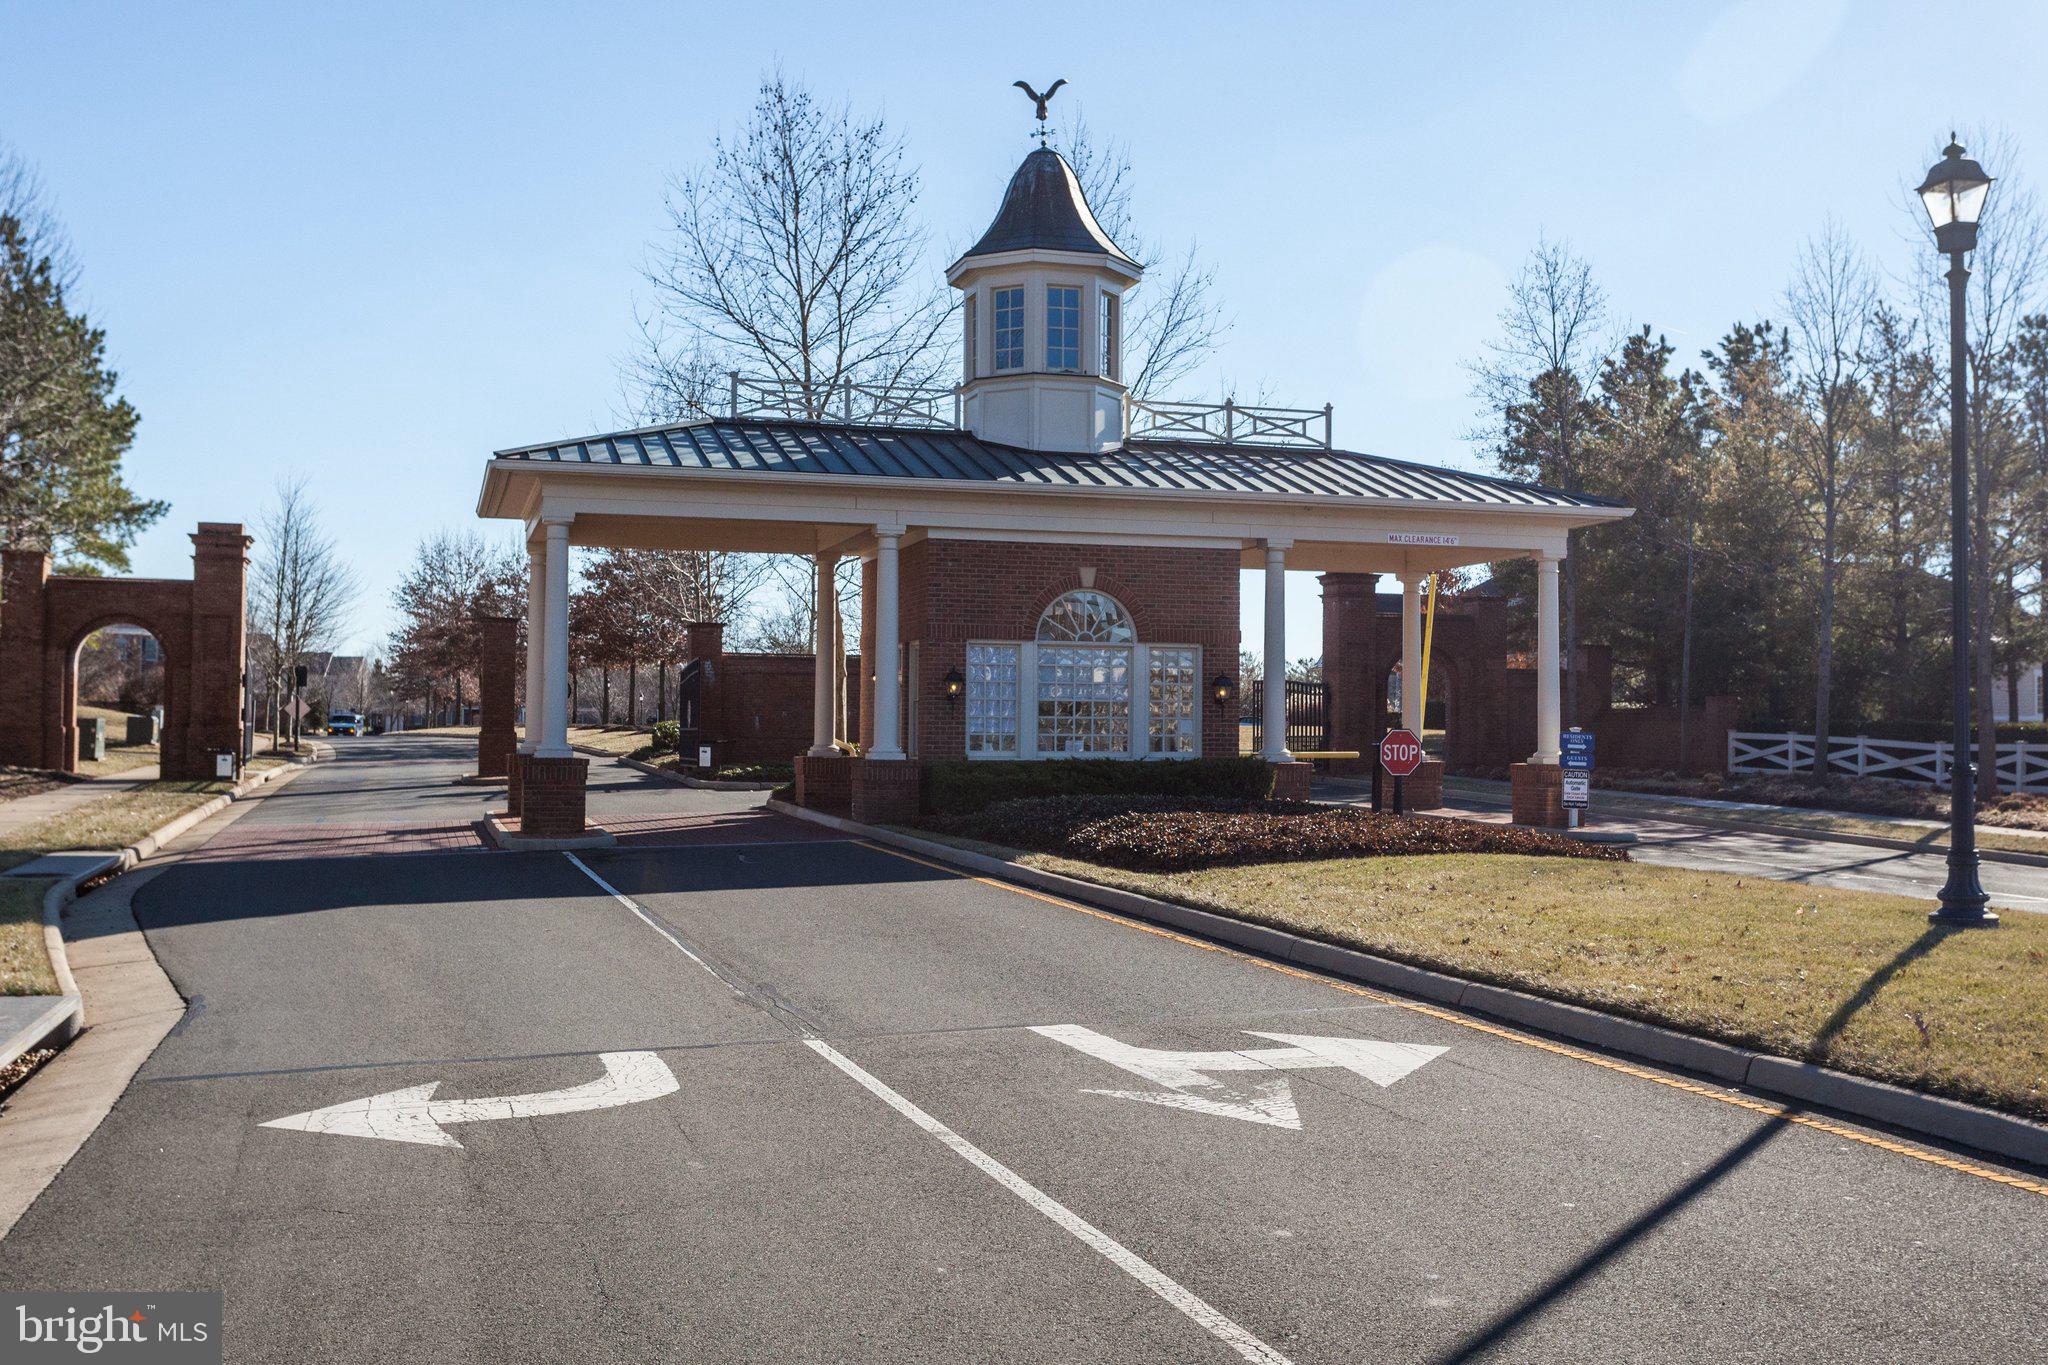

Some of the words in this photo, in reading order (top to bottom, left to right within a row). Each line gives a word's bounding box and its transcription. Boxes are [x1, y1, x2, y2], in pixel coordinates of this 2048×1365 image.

[1389, 534, 1402, 543] MAX
[1404, 535, 1441, 544] CLEARANCE
[1383, 744, 1418, 761] STOP
